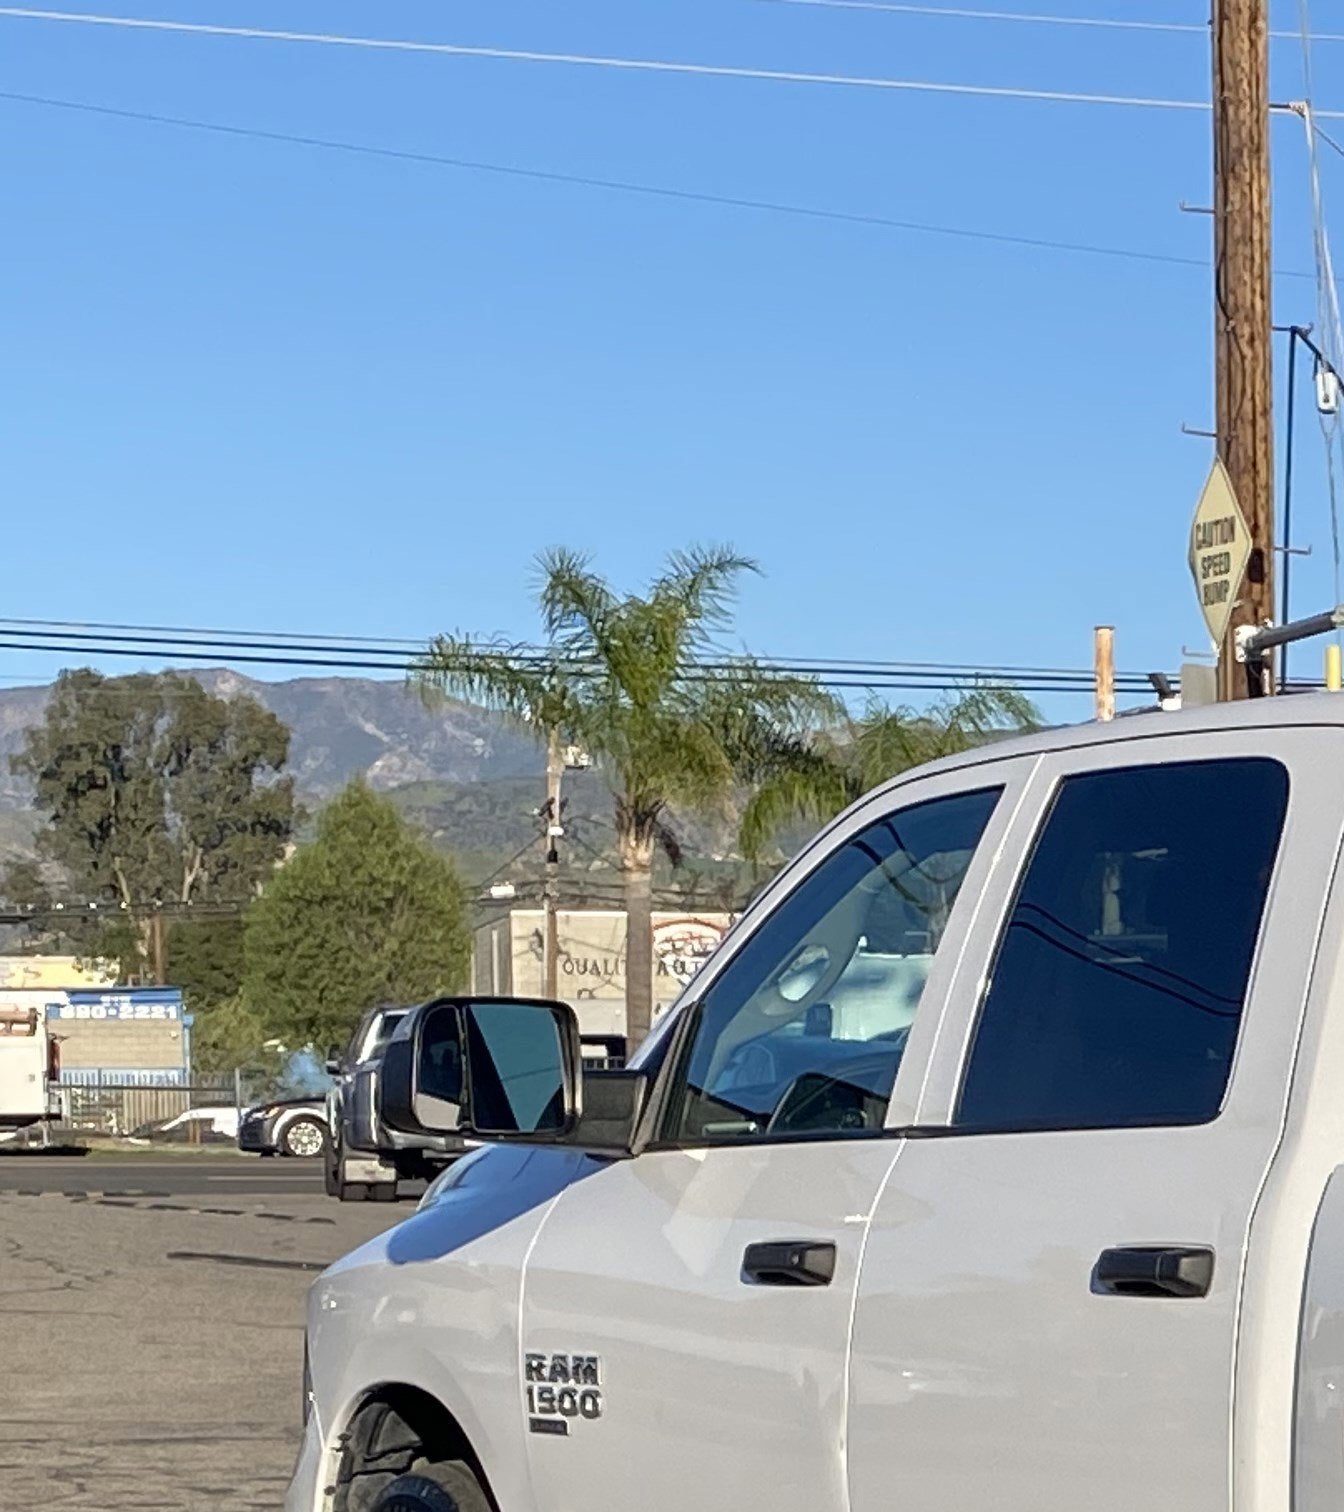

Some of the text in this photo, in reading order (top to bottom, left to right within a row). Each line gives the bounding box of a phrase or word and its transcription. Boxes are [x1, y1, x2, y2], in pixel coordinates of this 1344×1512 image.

[1201, 552, 1231, 579] SPEED
[562, 957, 703, 976] QUALI AUT
[525, 1353, 600, 1386] RAM
[526, 1385, 603, 1419] 1500
